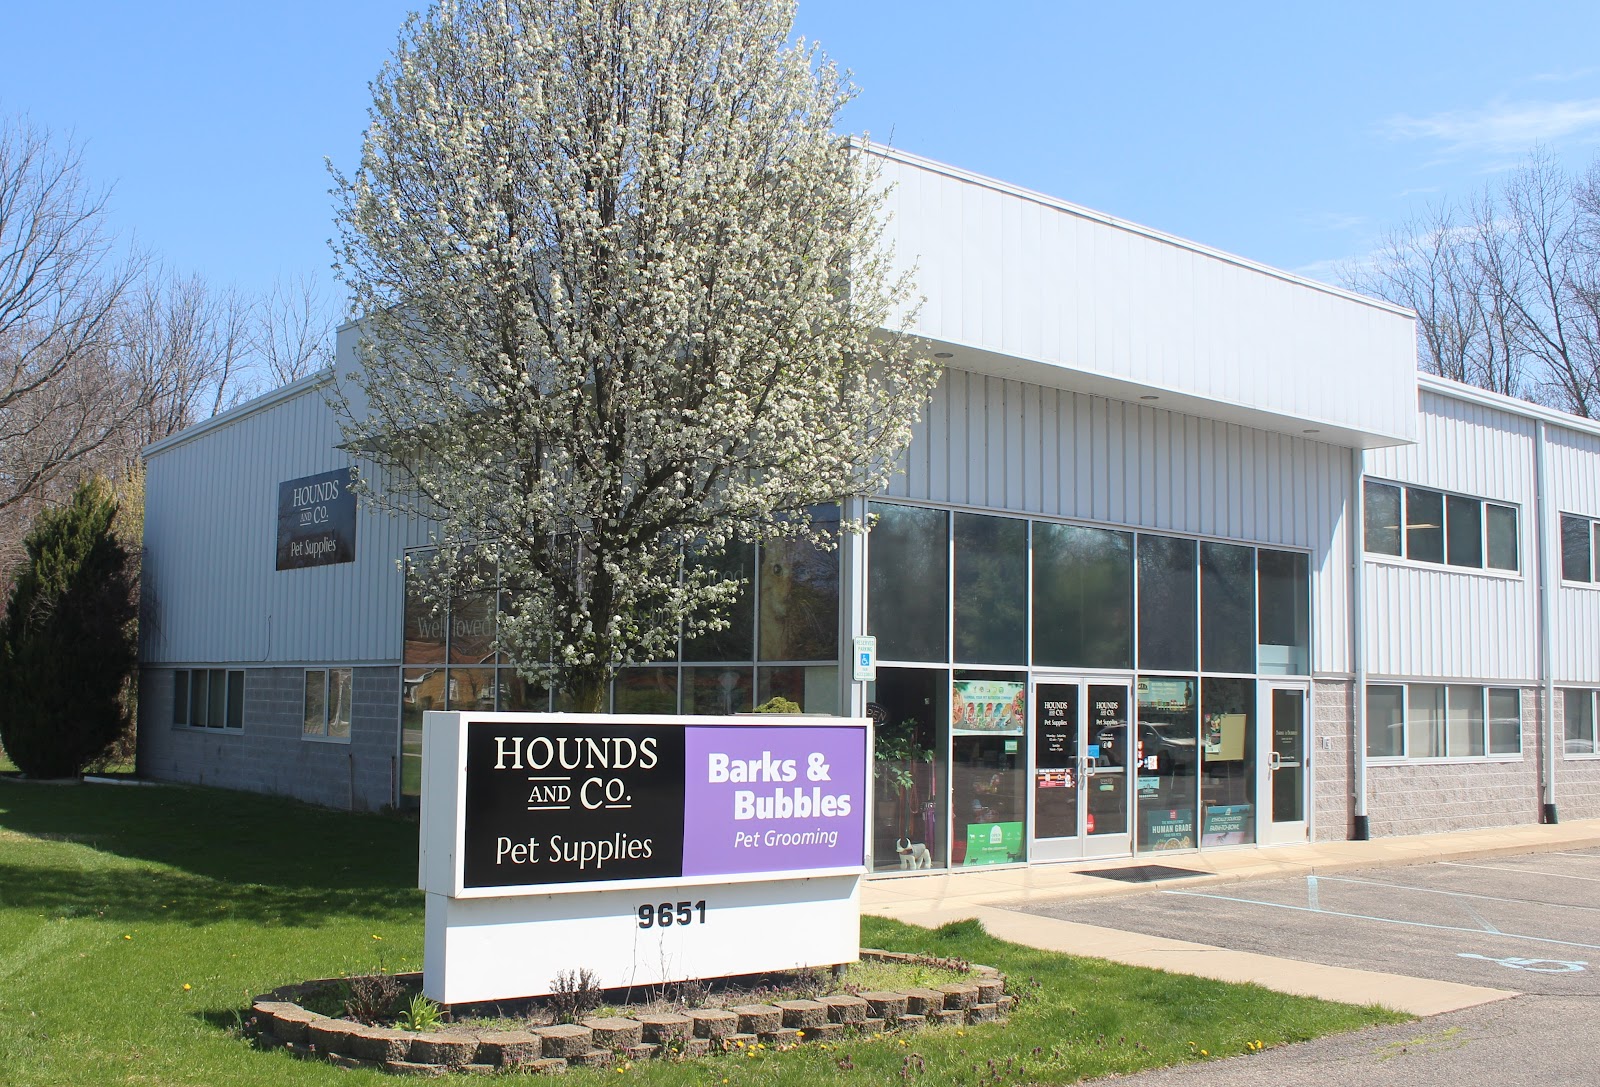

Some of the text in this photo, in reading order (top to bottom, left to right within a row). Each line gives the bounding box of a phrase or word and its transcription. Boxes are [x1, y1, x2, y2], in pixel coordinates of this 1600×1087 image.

[293, 480, 339, 507] HOUNDS
[300, 511, 312, 522] AND
[291, 537, 336, 558] Pet Supplies
[1044, 701, 1068, 709] HOUNDS
[1096, 701, 1119, 709] HOUNDS
[494, 737, 658, 770] HOUNDS
[708, 751, 832, 783] Barks &
[528, 785, 571, 803] AND
[734, 787, 851, 820] Bubbles
[734, 828, 838, 848] Pet Grooming
[1152, 823, 1192, 834] HUMAN GRADE
[496, 832, 653, 870] Pet Supplies
[638, 900, 706, 929] 9651
